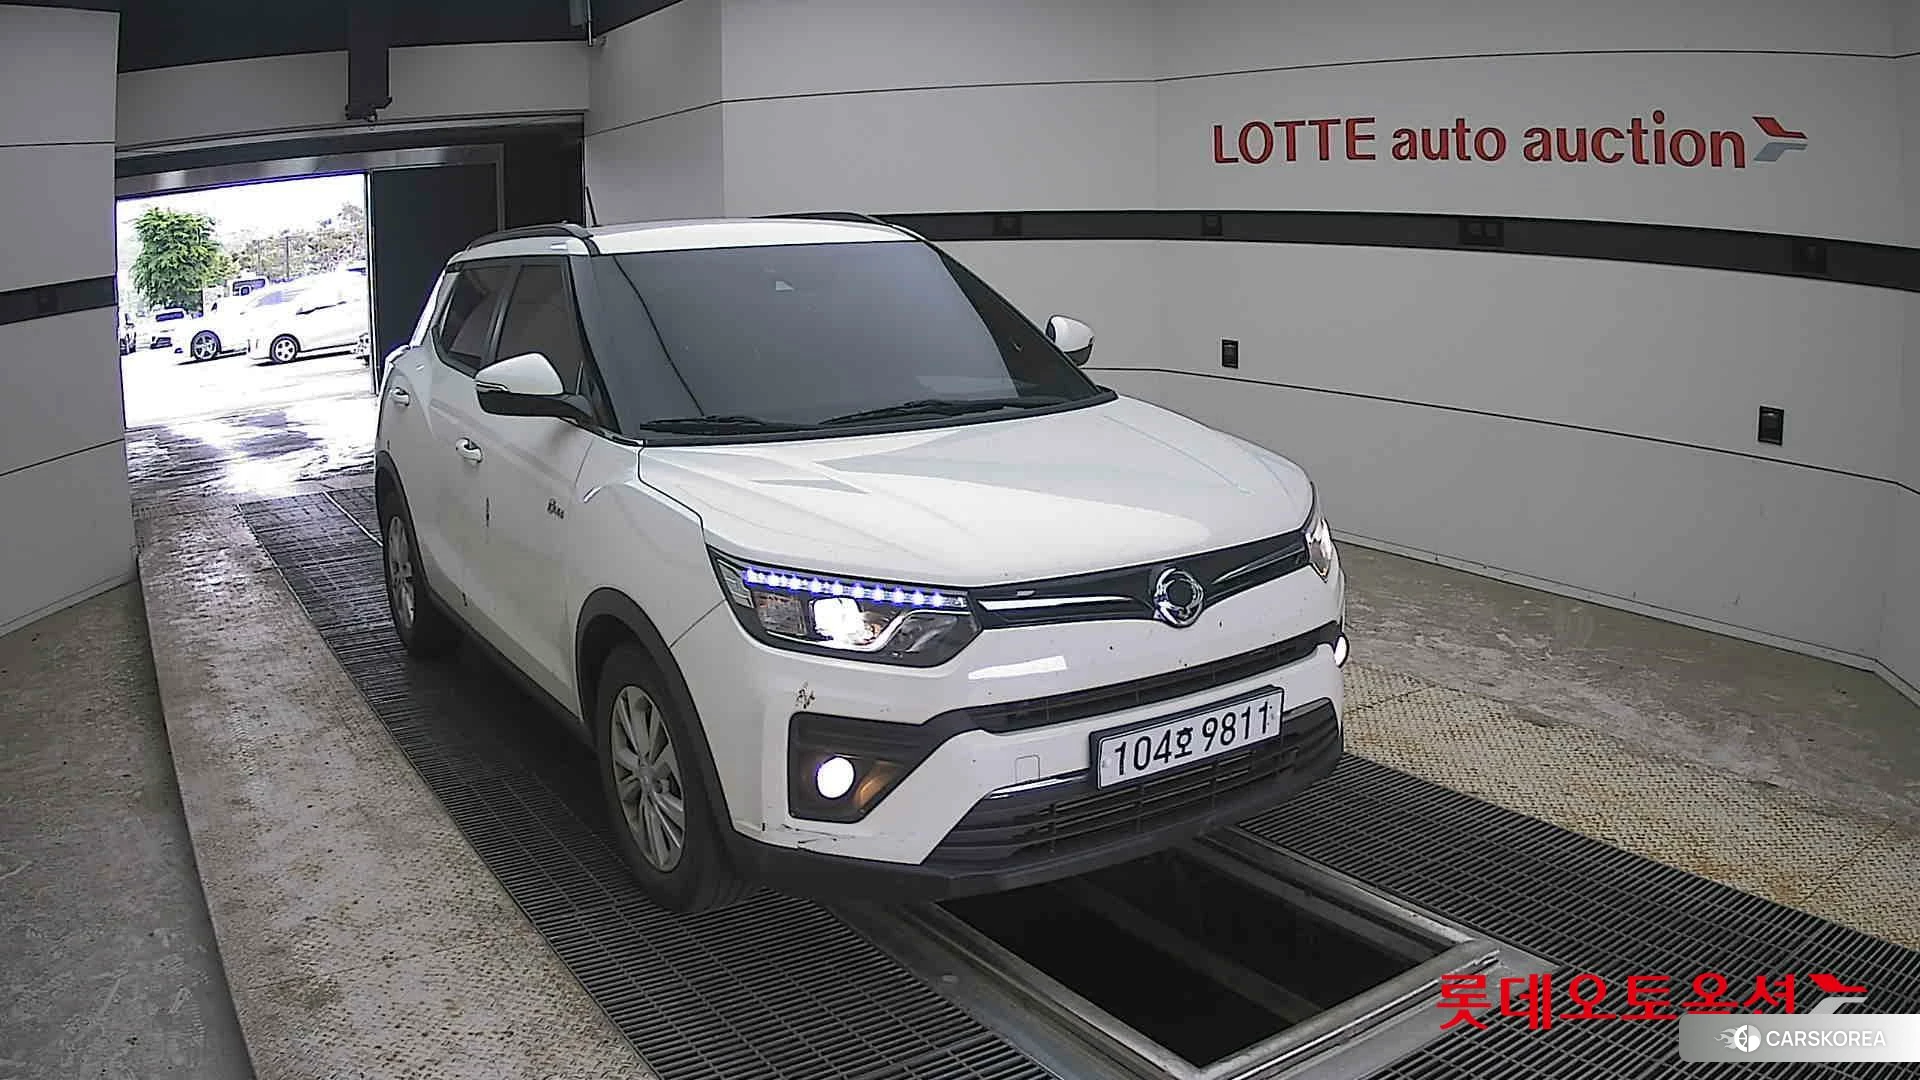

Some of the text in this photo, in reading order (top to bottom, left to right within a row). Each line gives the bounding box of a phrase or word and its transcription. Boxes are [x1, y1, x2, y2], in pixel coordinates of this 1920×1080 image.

[1213, 110, 1747, 169] LOTTE auto auction
[1201, 701, 1268, 752] 9811
